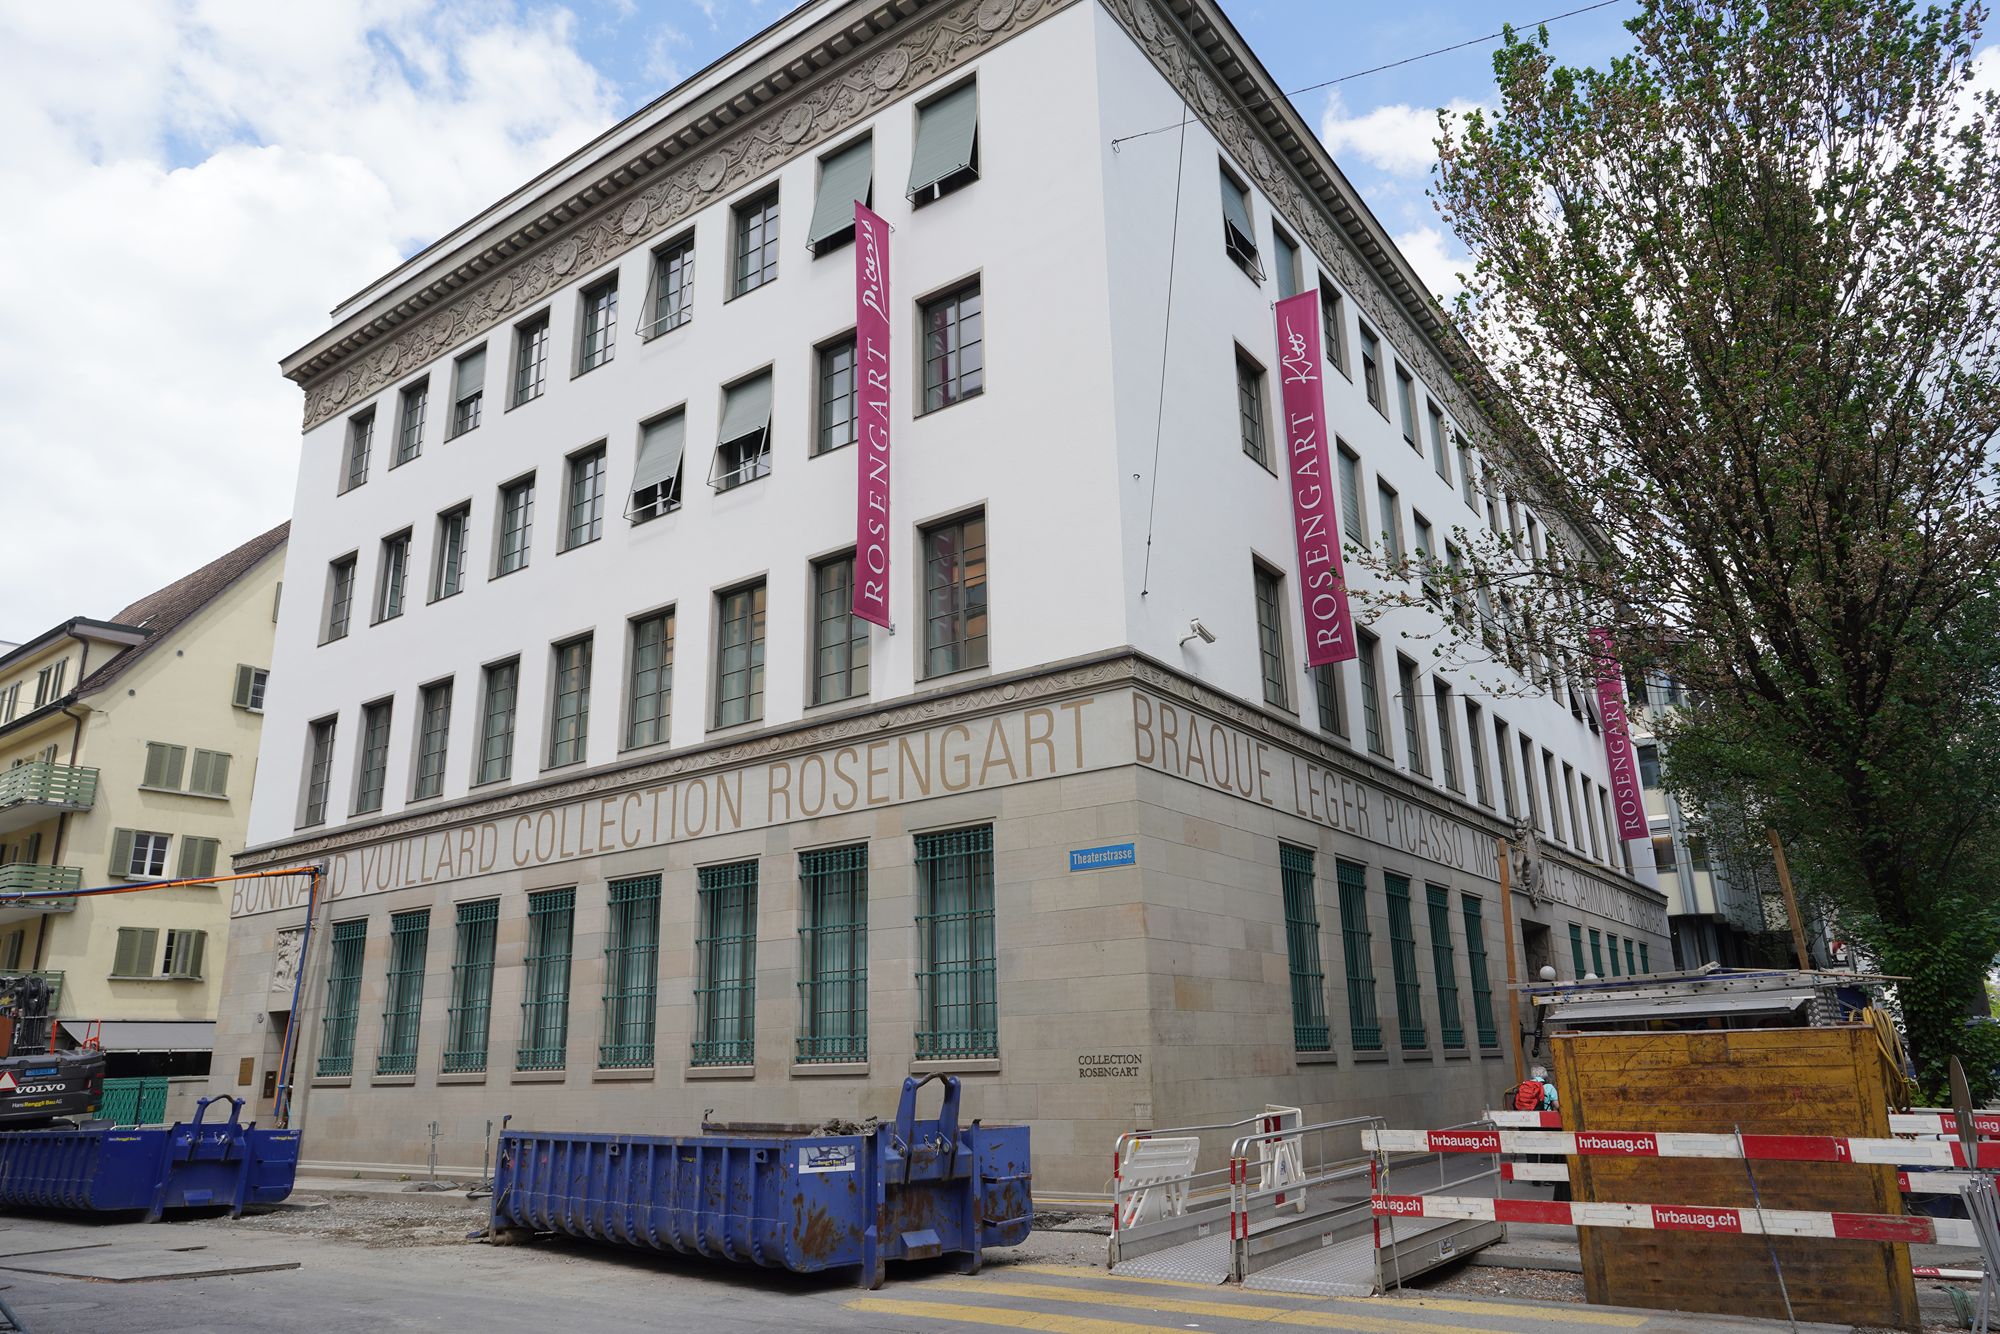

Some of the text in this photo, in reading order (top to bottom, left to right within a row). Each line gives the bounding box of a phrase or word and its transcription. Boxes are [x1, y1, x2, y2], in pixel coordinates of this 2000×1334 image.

[1283, 316, 1318, 384] Klee
[865, 337, 888, 607] ROSENGART
[1291, 411, 1343, 650] ROSENGART
[1603, 697, 1640, 832] ROSENGART
[1132, 691, 1274, 805] BRAQUE
[1291, 756, 1371, 838] LEGER
[1383, 795, 1464, 869] PICASSO
[231, 697, 1095, 915] BONNAD VUILLARD COLLECTION ROSENGART
[1072, 847, 1133, 866] Theaterstrasse
[1078, 1054, 1142, 1066] COLLECTION
[1079, 1066, 1140, 1078] ROSENGART
[16, 1083, 66, 1094] VOLVO
[1431, 1133, 1497, 1148] hrbauag.ch
[1578, 1136, 1654, 1152] hrbauag.ch
[1655, 1209, 1737, 1228] hrbauag.ch
